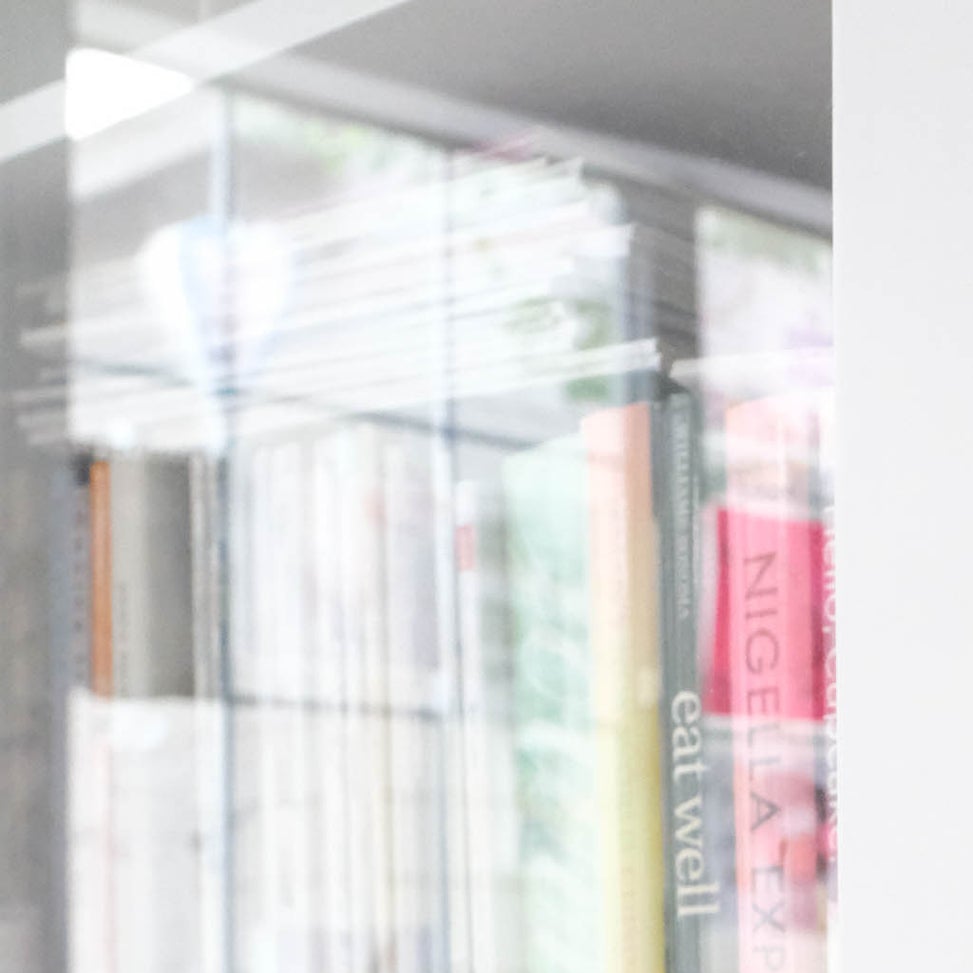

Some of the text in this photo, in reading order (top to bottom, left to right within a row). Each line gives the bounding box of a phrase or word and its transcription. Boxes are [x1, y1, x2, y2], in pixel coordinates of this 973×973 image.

[671, 690, 721, 918] eat well
[743, 551, 781, 832] NIGELLA
